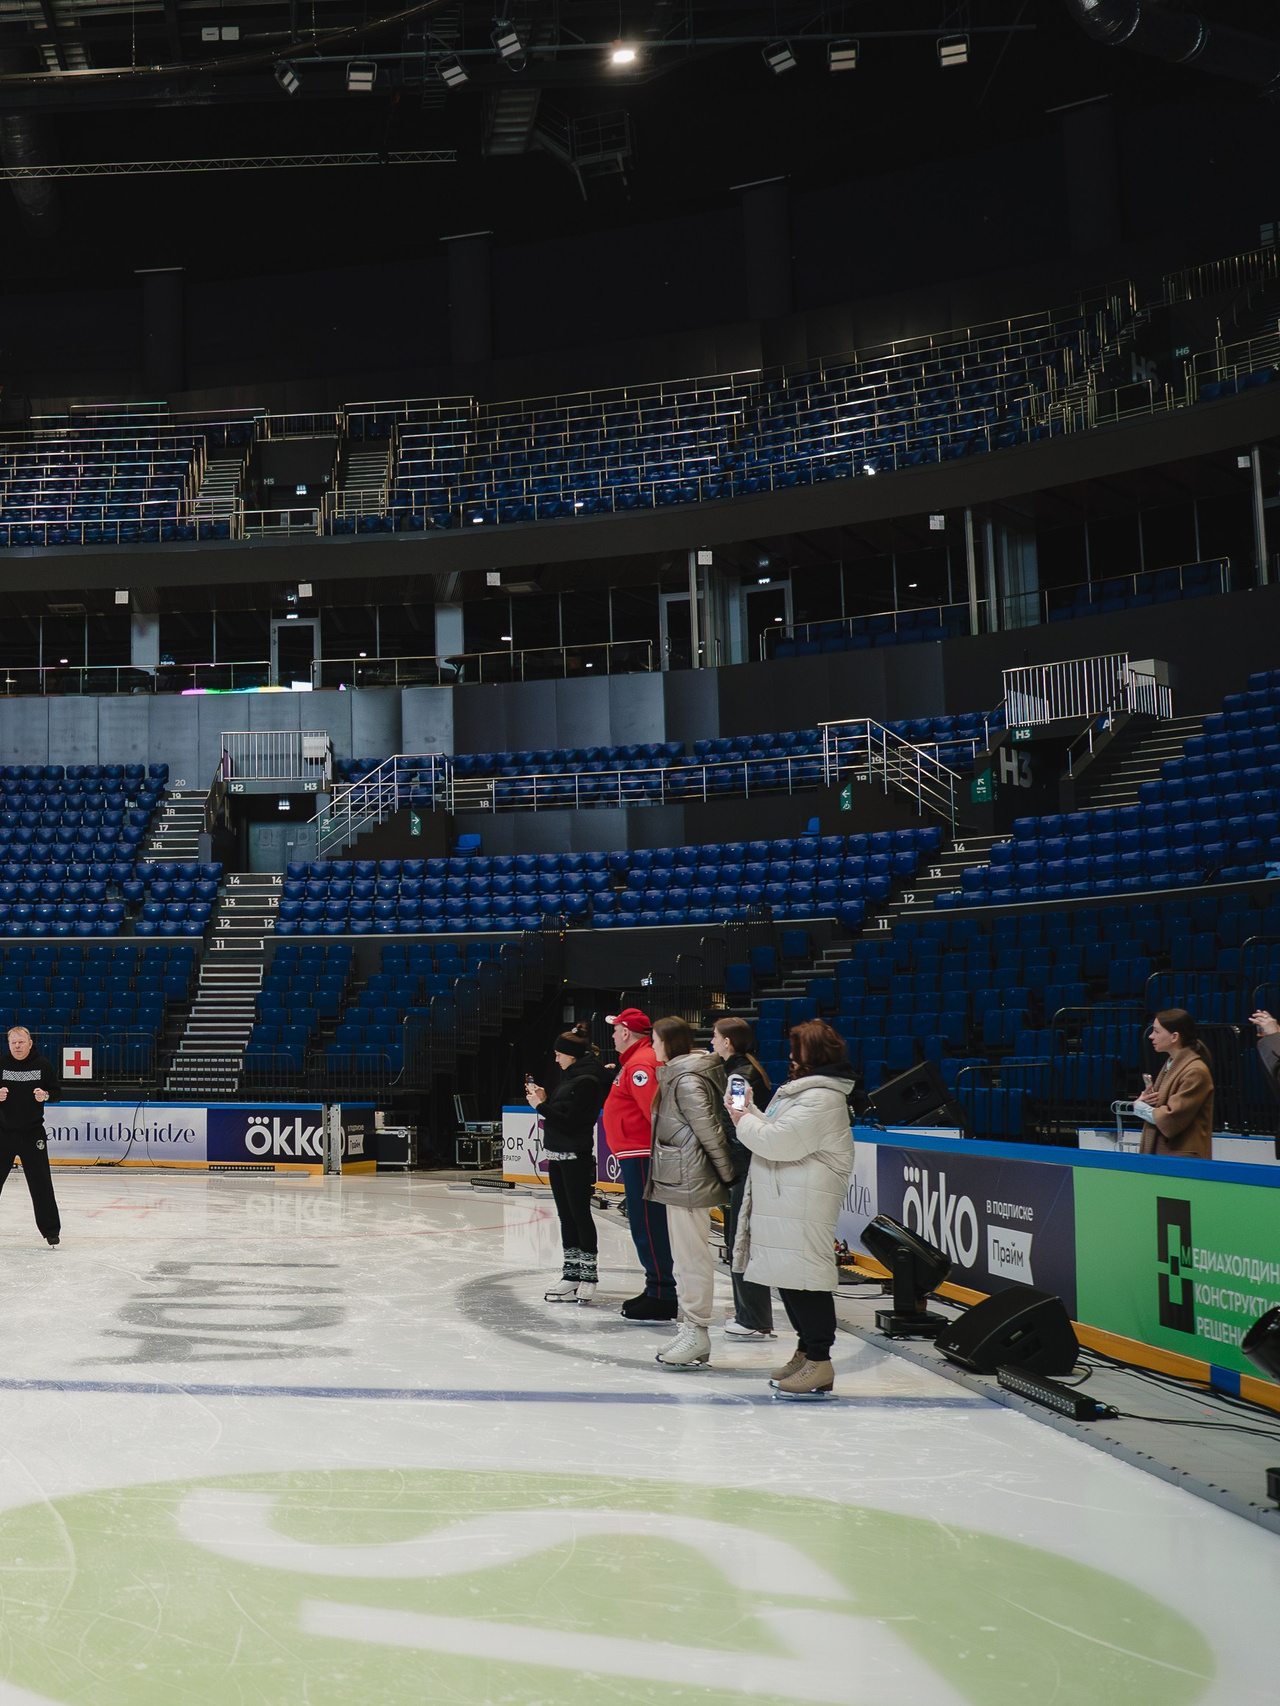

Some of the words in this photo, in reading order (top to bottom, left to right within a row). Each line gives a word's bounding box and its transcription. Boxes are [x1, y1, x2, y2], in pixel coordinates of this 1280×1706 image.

[1015, 729, 1030, 739] H3
[999, 747, 1033, 788] H3
[174, 779, 186, 787] 20
[304, 783, 317, 791] H3
[231, 784, 244, 792] H2
[953, 843, 965, 852] 14
[930, 869, 942, 878] 13
[230, 876, 240, 884] 14
[272, 876, 282, 884] 14
[268, 898, 279, 906] 13
[903, 894, 915, 903] 12
[220, 919, 230, 927] 12
[264, 919, 274, 927] 12
[878, 919, 888, 929] 11
[216, 940, 224, 948] 11
[81, 1122, 195, 1143] Tutberidze
[986, 1200, 992, 1213] в
[993, 1200, 1033, 1221] подписке
[992, 1239, 1024, 1268] Прайм
